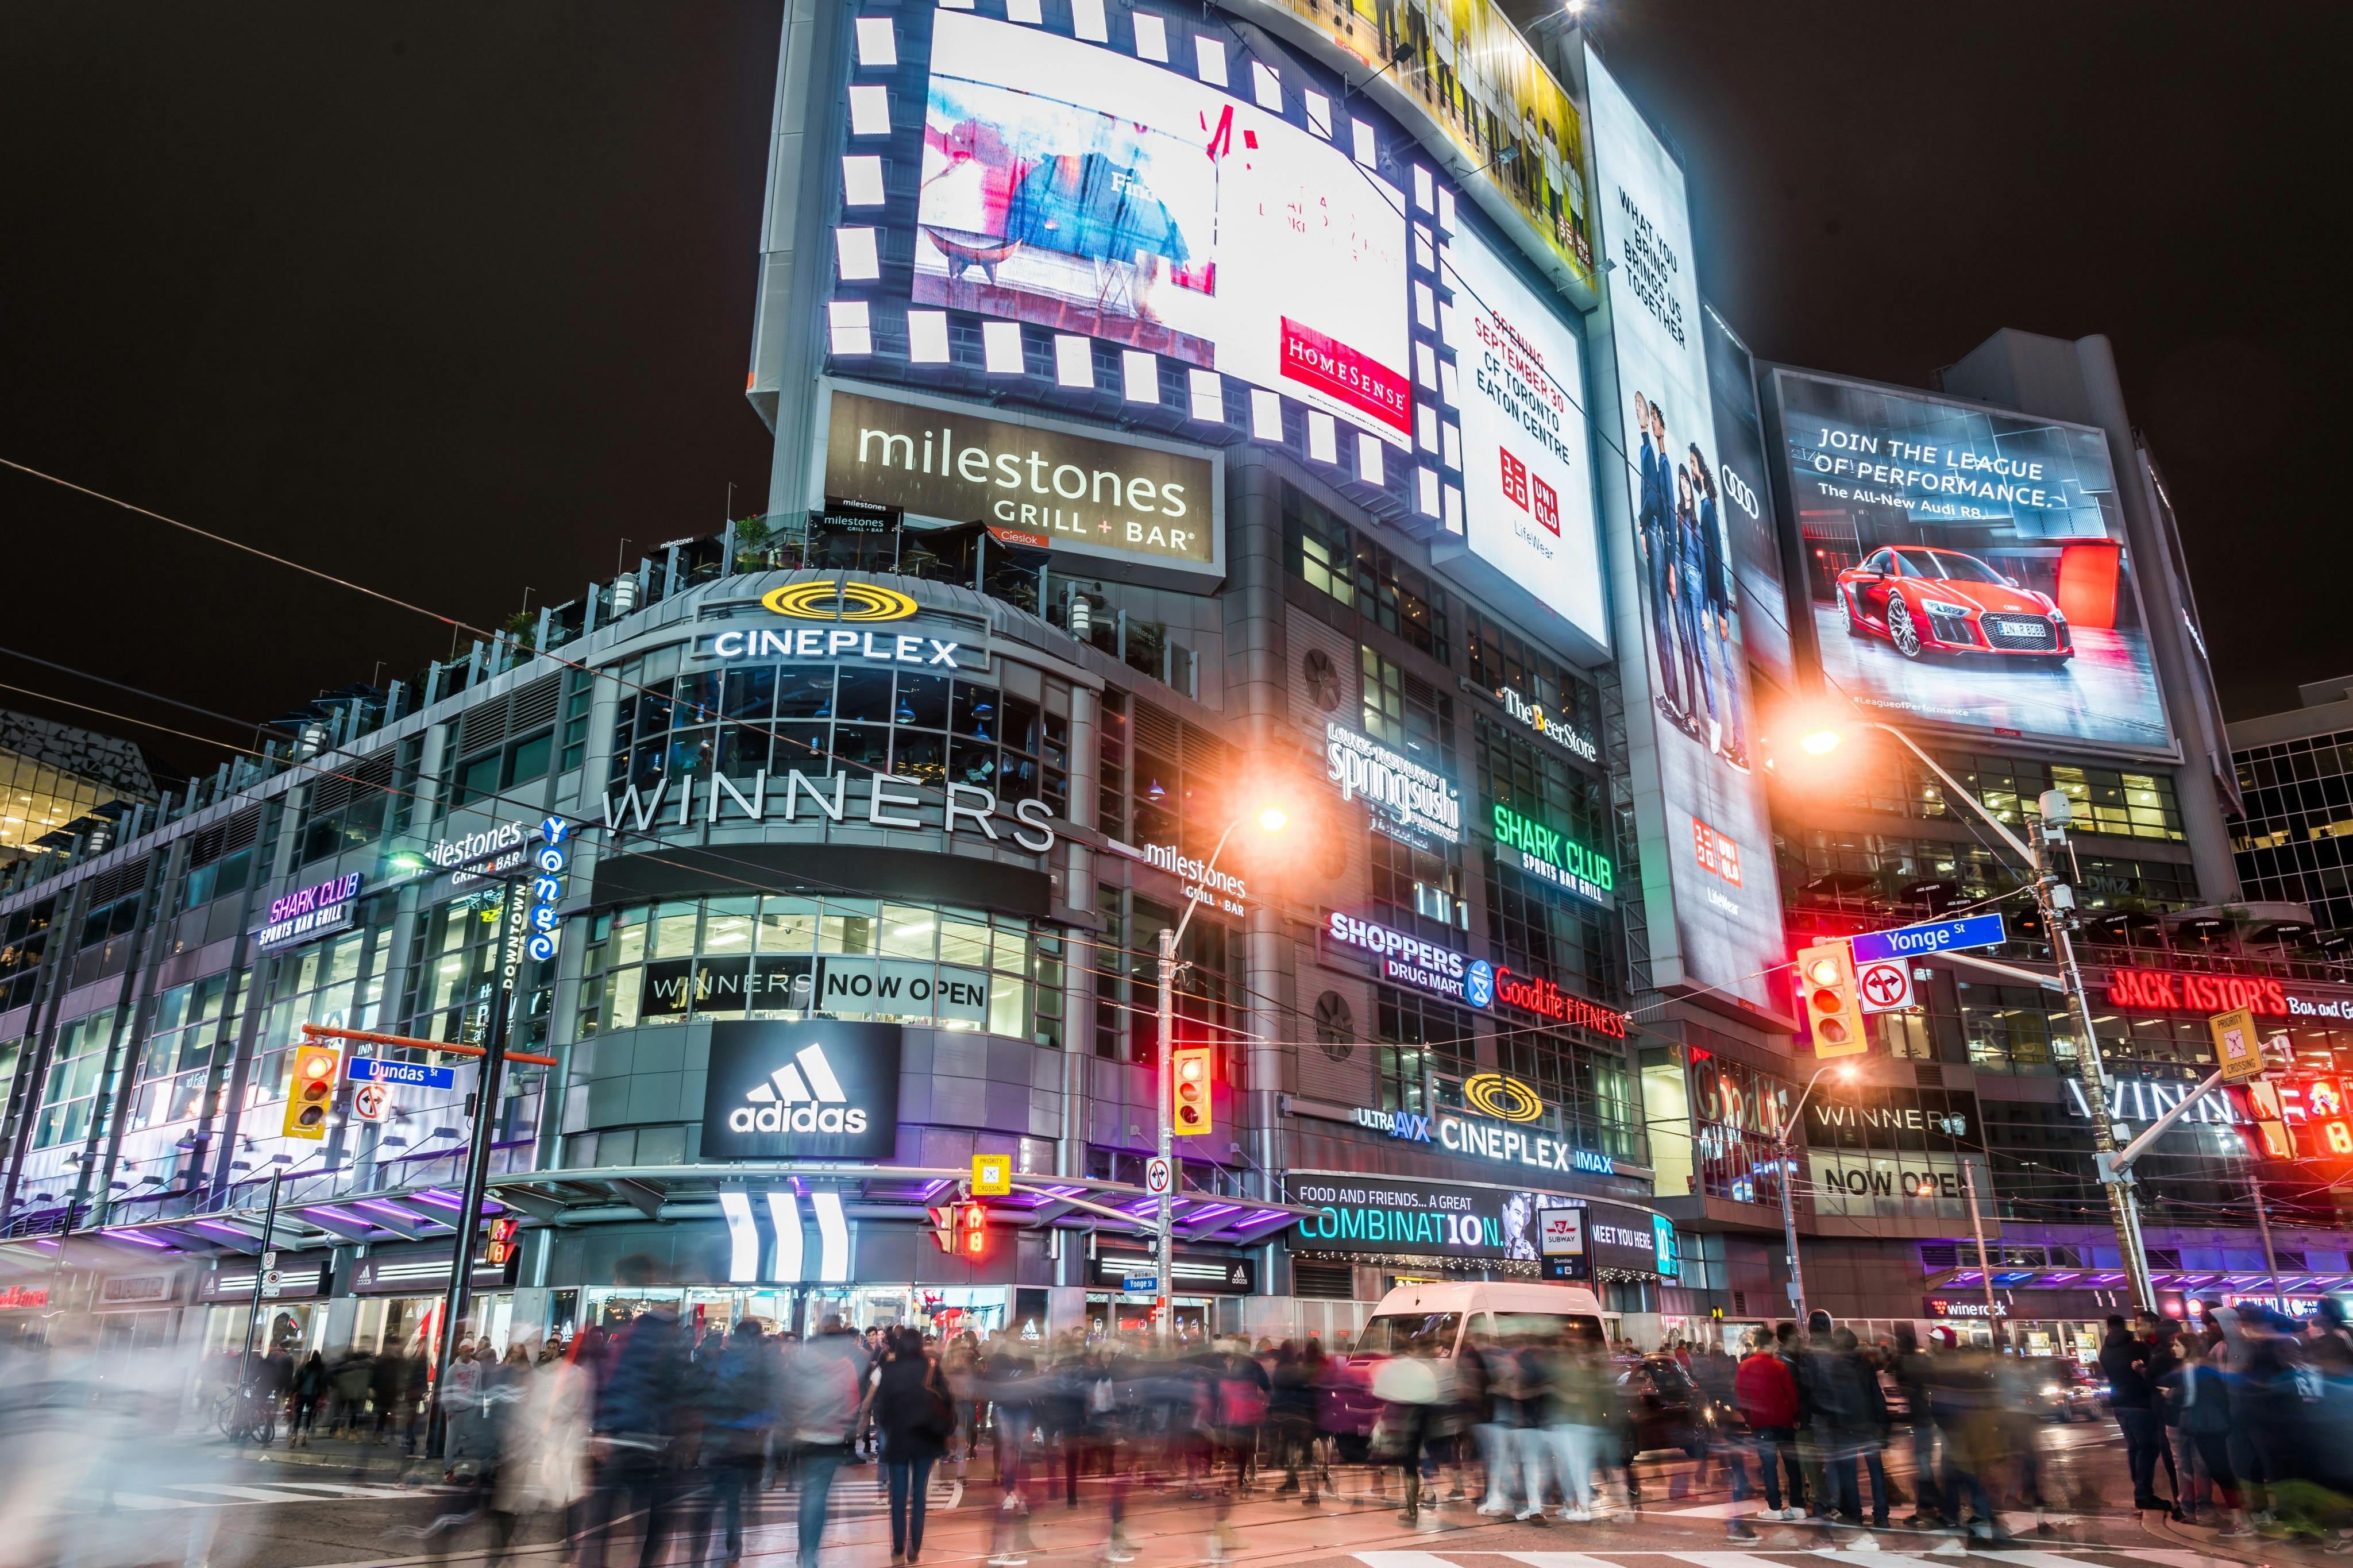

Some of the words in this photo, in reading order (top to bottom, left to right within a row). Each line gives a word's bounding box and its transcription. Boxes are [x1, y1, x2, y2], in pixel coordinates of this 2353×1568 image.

[1618, 185, 1652, 242] WHAT
[1657, 233, 1677, 273] YOU
[1634, 229, 1668, 283] BRING
[1624, 238, 1665, 303] BRINGS
[1668, 292, 1682, 323] US
[1625, 264, 1685, 350] TOGETHER
[1492, 310, 1544, 372] OPENING
[1475, 317, 1548, 399] SEPTEMBER
[1550, 388, 1564, 414] 30
[1484, 352, 1500, 373] CF
[1504, 368, 1560, 432] TORONTO
[1477, 368, 1520, 422] EATON
[1523, 411, 1570, 466] CENTRE
[859, 427, 1187, 517] milestones
[1818, 428, 1878, 453] JOIN
[1888, 440, 1938, 464] THE
[1946, 450, 2043, 480] LEAGUE
[1815, 455, 1849, 474] OF
[1858, 462, 2053, 508] PERFORMANCE.
[1818, 482, 1848, 499] The
[1853, 491, 1915, 509] All-New
[1920, 500, 1955, 517] Audi
[824, 515, 884, 527] milestones
[842, 499, 886, 512] milestones
[994, 499, 1087, 534] GRILL
[1001, 531, 1037, 544] Cieslok
[1514, 519, 1554, 561] LifeWear
[714, 628, 959, 668] CINEPLEX
[1853, 696, 1969, 717] #LeagueofPerformance
[601, 768, 1055, 852] WINNERS
[495, 852, 521, 871] BAR
[1494, 805, 1563, 868] SHARK
[1565, 840, 1613, 891] CLUB
[269, 886, 319, 924] SHARK
[319, 871, 359, 907] CLUB
[529, 816, 566, 961] Yonge
[1522, 852, 1557, 882] SPORTS
[1559, 869, 1577, 890] BAR
[1579, 878, 1602, 902] GRILL
[259, 921, 293, 945] SPORTS
[294, 914, 314, 933] BAR
[315, 904, 342, 926] GRILL
[1224, 899, 1244, 918] BAR
[503, 884, 527, 990] DOWNTOWN
[1328, 911, 1464, 978] SHOPPERS
[1886, 927, 1950, 951] Yonge
[1954, 923, 1965, 934] St
[653, 973, 813, 1000] WINNERS
[827, 973, 903, 998] NOW
[909, 978, 985, 1007] OPEN
[1388, 959, 1428, 985] DRUG
[1429, 972, 1464, 998] MART
[2109, 970, 2178, 1009] JACK
[2183, 975, 2287, 1015] ASTOR'S
[2286, 997, 2317, 1015] Bar
[2318, 997, 2340, 1017] and
[1567, 997, 1625, 1039] FITNESS
[2216, 1013, 2243, 1029] PRIORITY
[369, 1061, 425, 1082] Dundas
[430, 1068, 438, 1077] St
[2226, 1058, 2255, 1074] CROSSING
[729, 1098, 867, 1133] adidas
[1441, 1118, 1569, 1172] CINEPLEX
[1575, 1150, 1614, 1175] IMAX
[1300, 1185, 1336, 1202] FOOD
[1339, 1188, 1365, 1204] AND
[1369, 1191, 1427, 1208] FRIENDS...
[1429, 1194, 1437, 1208] A
[1439, 1195, 1472, 1211] GREAT
[1825, 1169, 1892, 1196] NOW
[1617, 1228, 1633, 1247] YOU
[1634, 1230, 1653, 1250] HERE.
[1656, 1227, 1669, 1262] 10
[1130, 1280, 1147, 1289] Yonge
[1232, 1276, 1248, 1285] adidas
